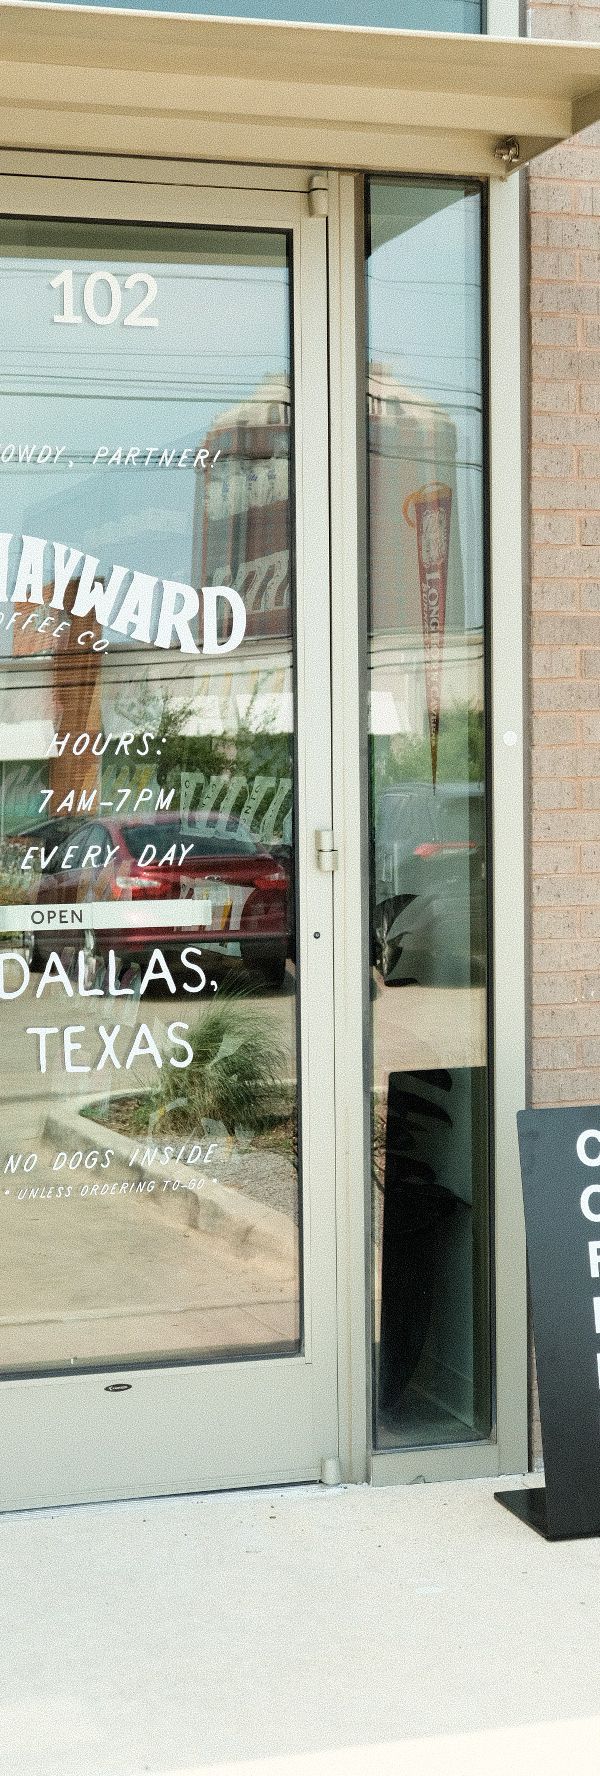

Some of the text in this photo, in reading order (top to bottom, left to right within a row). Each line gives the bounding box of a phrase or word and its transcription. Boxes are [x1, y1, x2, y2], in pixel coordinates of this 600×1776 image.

[49, 269, 160, 327] 102
[0, 444, 221, 469] OWDY, PARTNER!
[77, 631, 109, 655] CO.
[47, 732, 168, 757] HOURS:
[21, 843, 194, 870] EVERY DAY
[31, 908, 84, 925] OPEN
[0, 946, 218, 1000] DALLAS,
[27, 1022, 194, 1074] TEXAS
[4, 1143, 219, 1174] NO DOGS INSIDE
[17, 1186, 73, 1200] UNLESS
[81, 1181, 156, 1197] ORDERING
